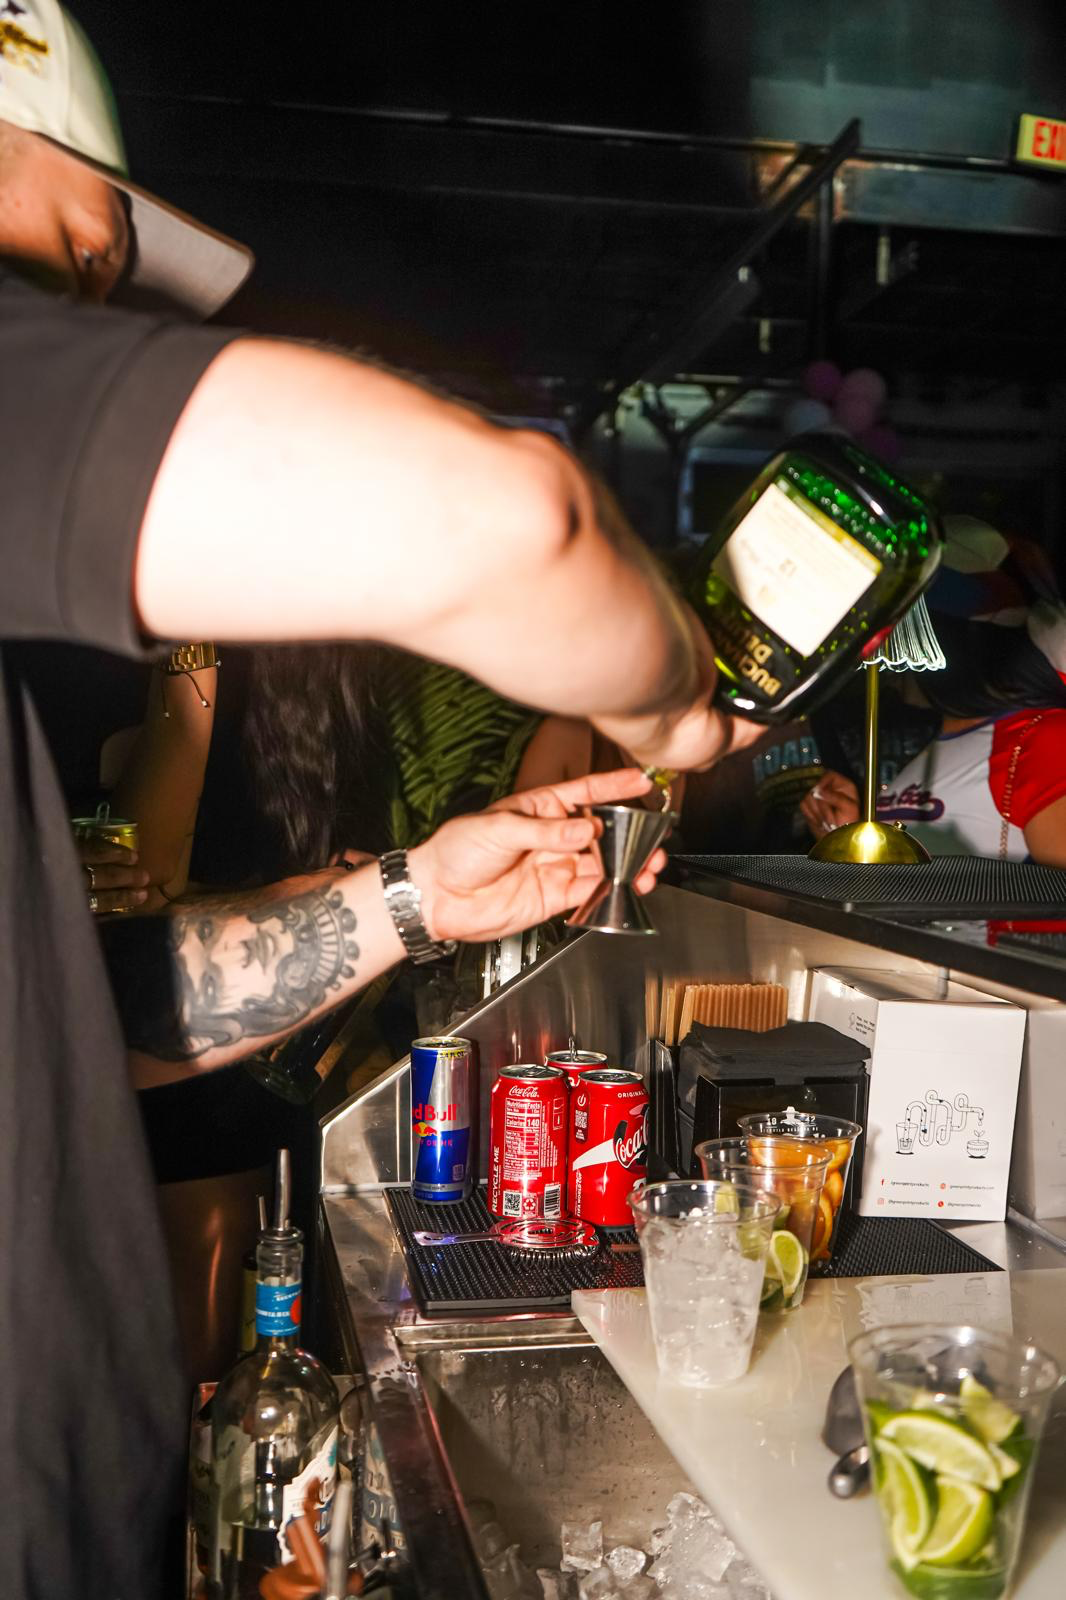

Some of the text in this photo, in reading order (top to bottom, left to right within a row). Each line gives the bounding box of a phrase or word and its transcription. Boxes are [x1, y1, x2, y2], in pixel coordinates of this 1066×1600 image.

[425, 1103, 457, 1121] Bull
[491, 1146, 500, 1213] RECYCLE ME
